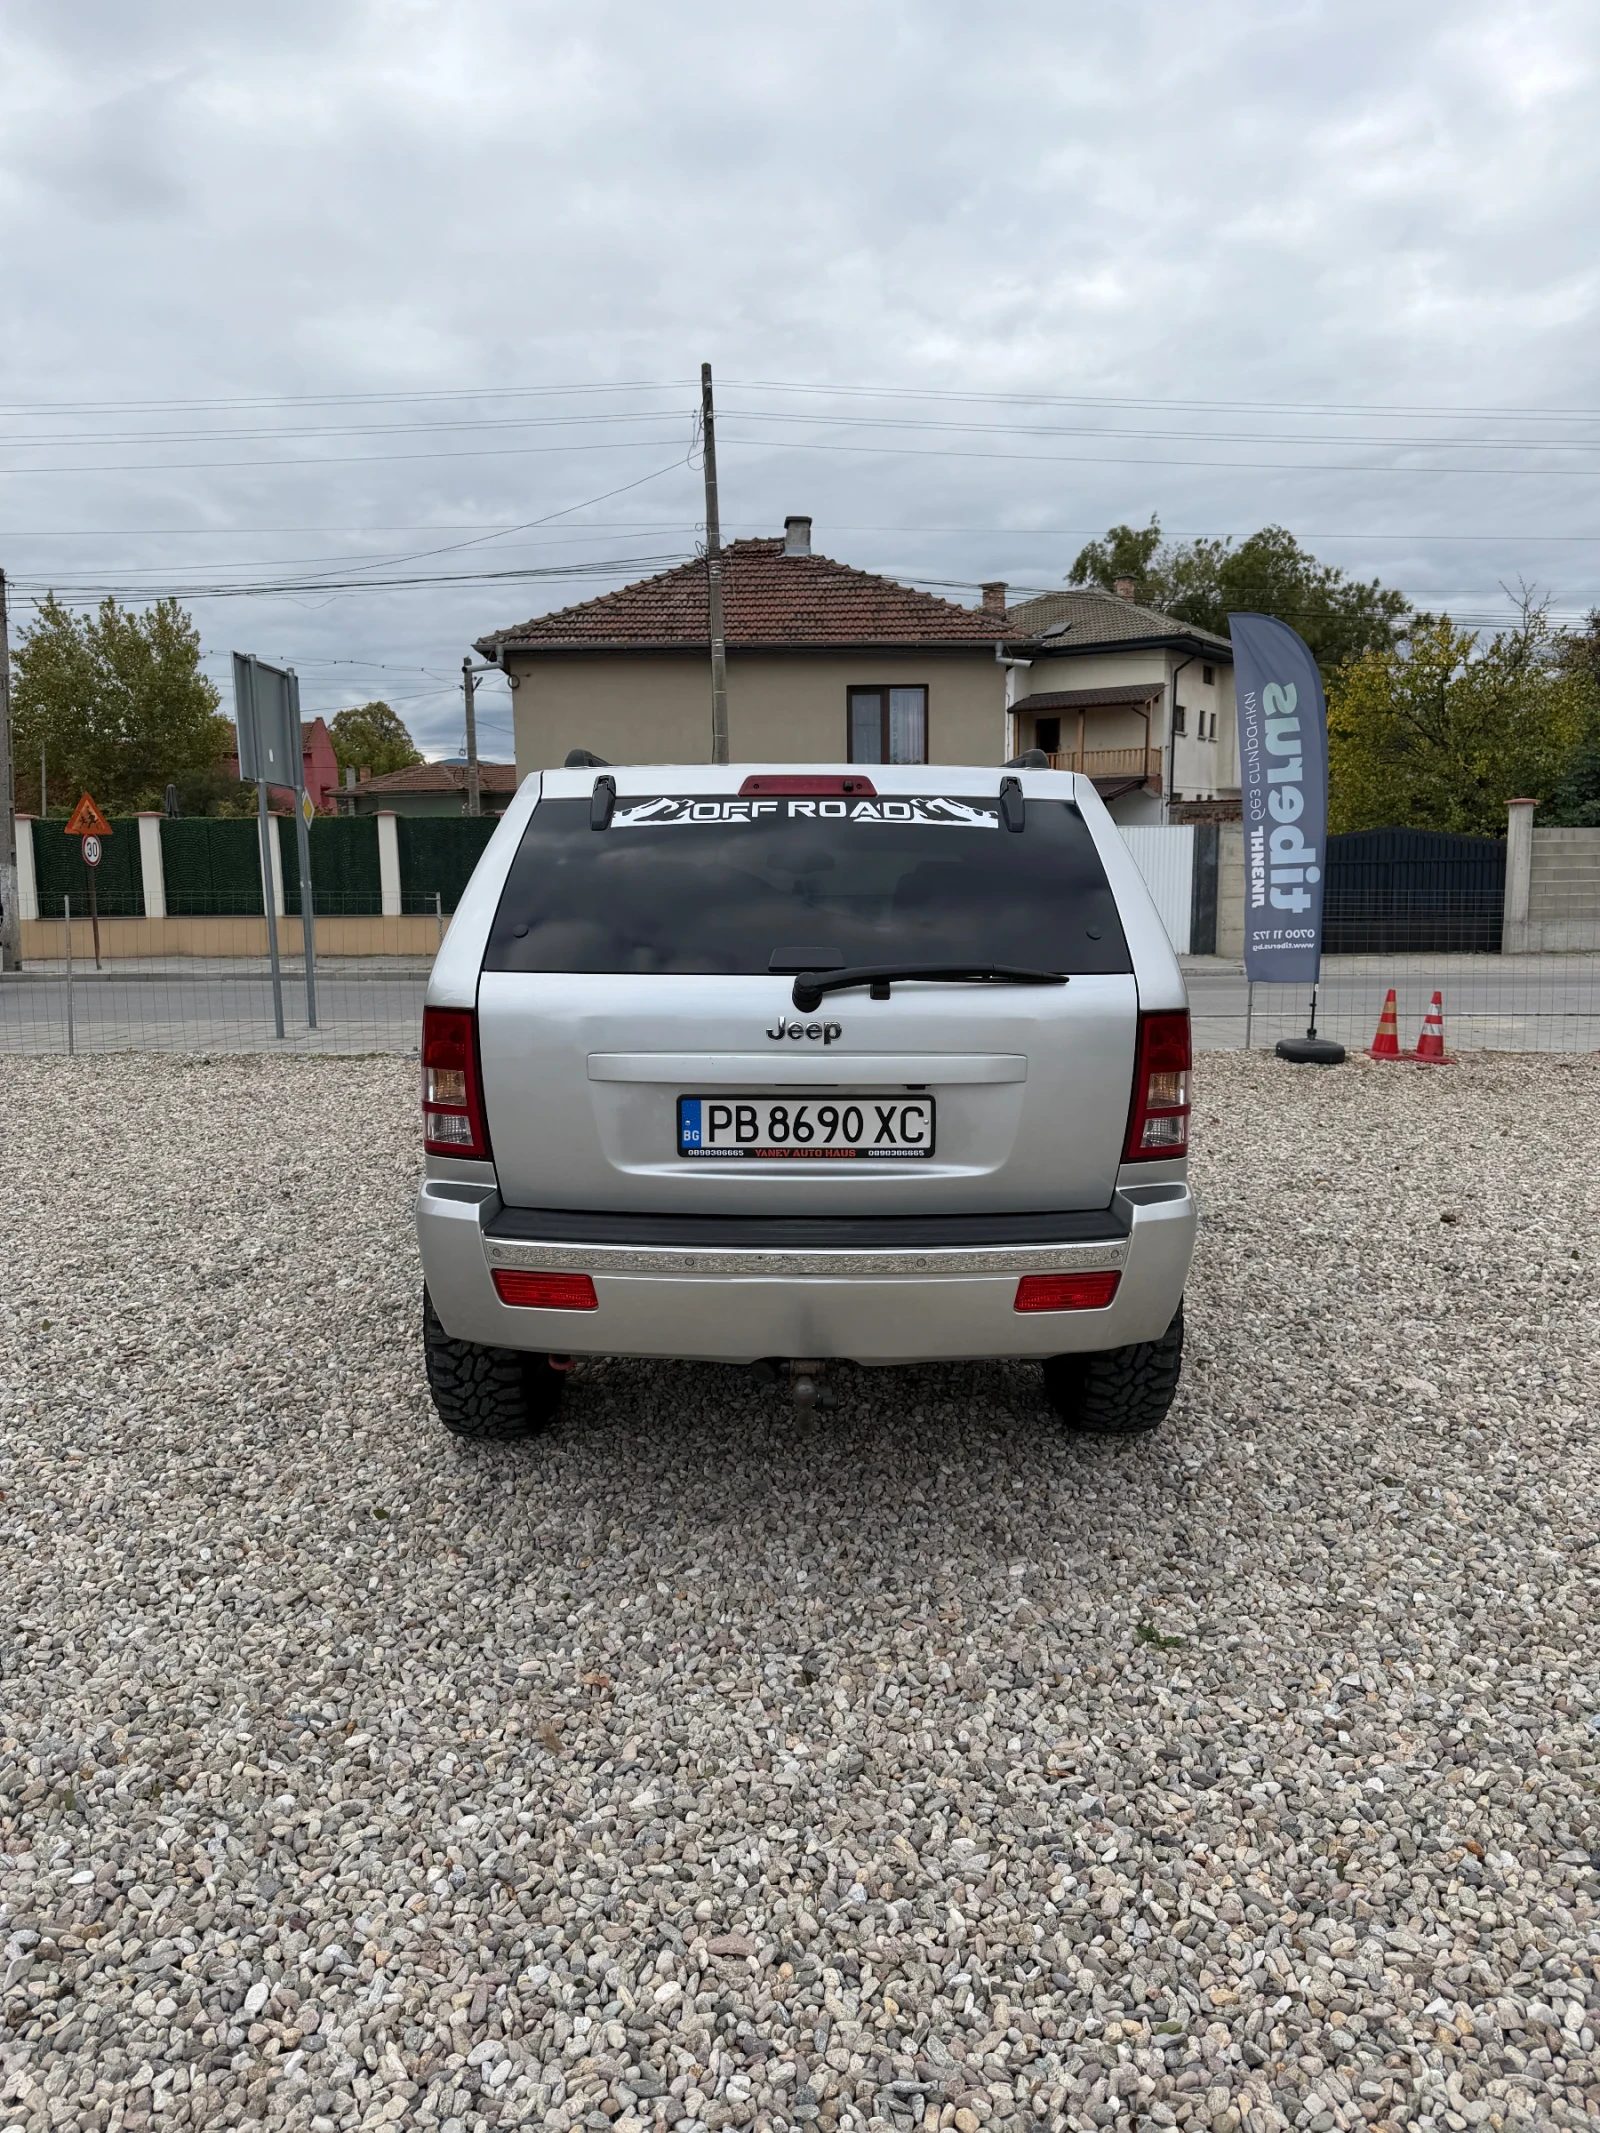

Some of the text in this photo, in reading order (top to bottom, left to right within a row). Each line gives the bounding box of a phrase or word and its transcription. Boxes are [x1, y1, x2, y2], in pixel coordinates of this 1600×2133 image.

[692, 801, 914, 820] OFF ROAD
[87, 842, 97, 857] 30
[766, 1016, 842, 1046] Jeep
[708, 1105, 925, 1143] PB 8690 XC
[683, 1130, 700, 1141] BG
[755, 1149, 856, 1157] YANEV AUTO HAUS
